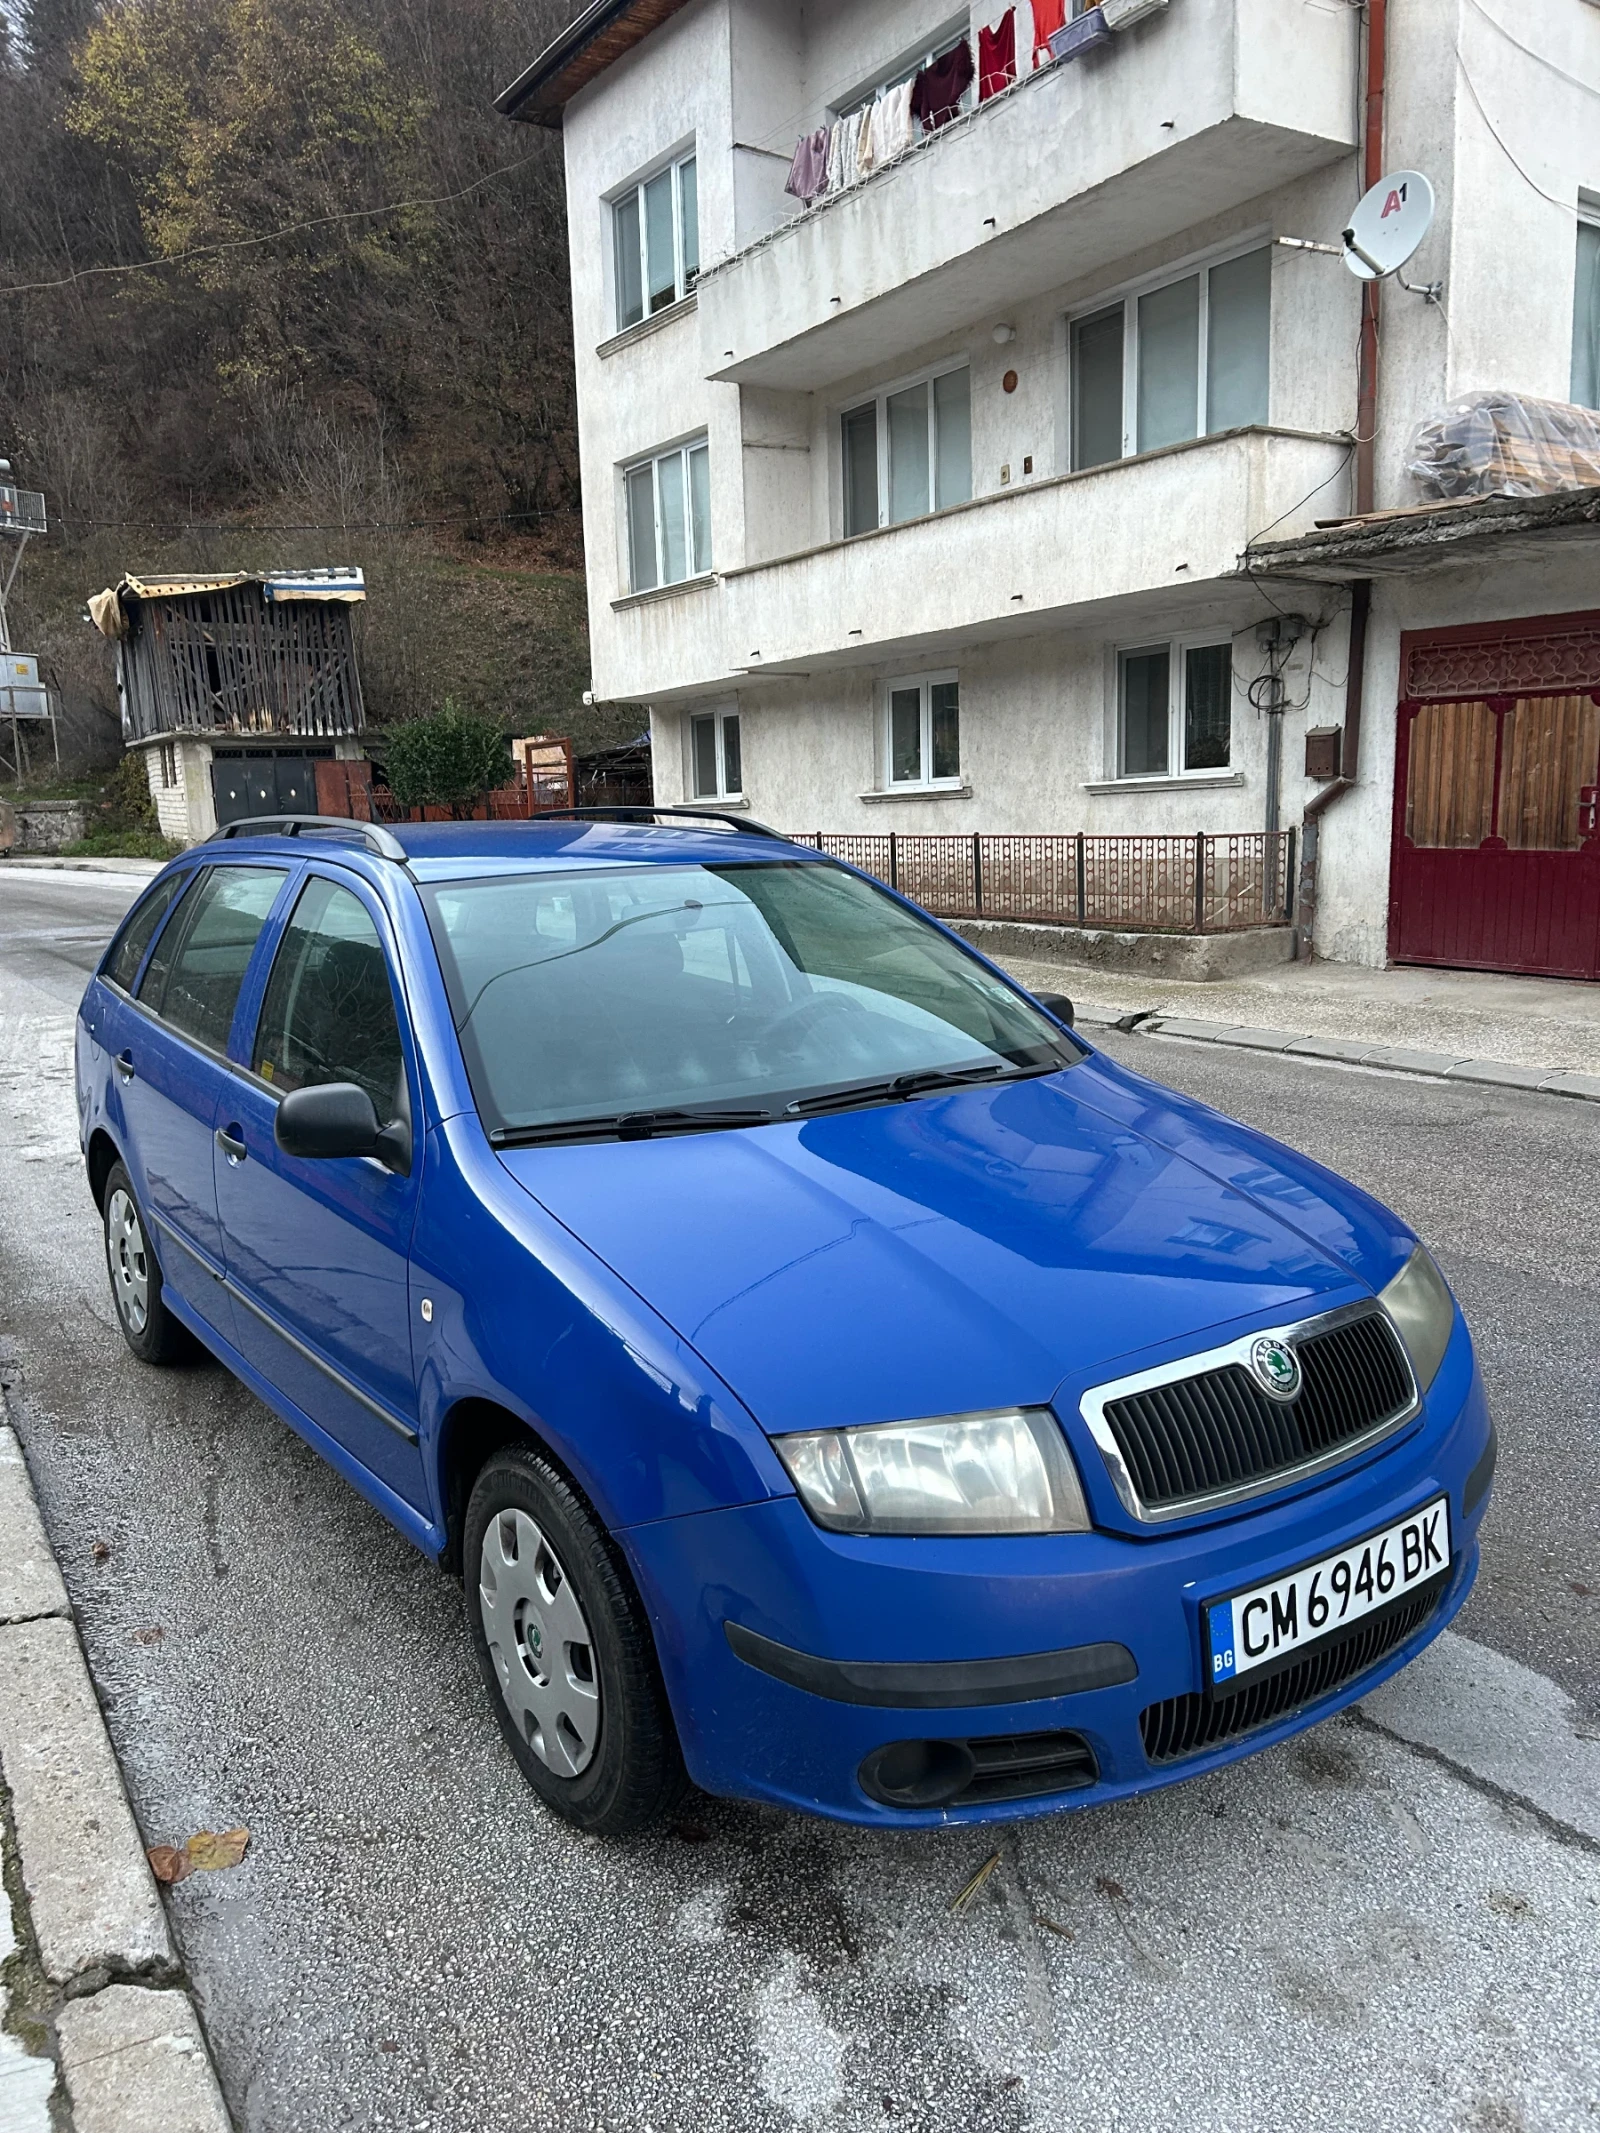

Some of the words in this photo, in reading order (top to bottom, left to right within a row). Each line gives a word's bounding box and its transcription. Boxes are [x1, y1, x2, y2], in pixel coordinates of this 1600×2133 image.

[1380, 182, 1407, 218] A1
[1242, 1583, 1298, 1657] CM
[1308, 1538, 1395, 1628] 6946
[1401, 1510, 1442, 1583] BK
[1213, 1649, 1233, 1673] BG
